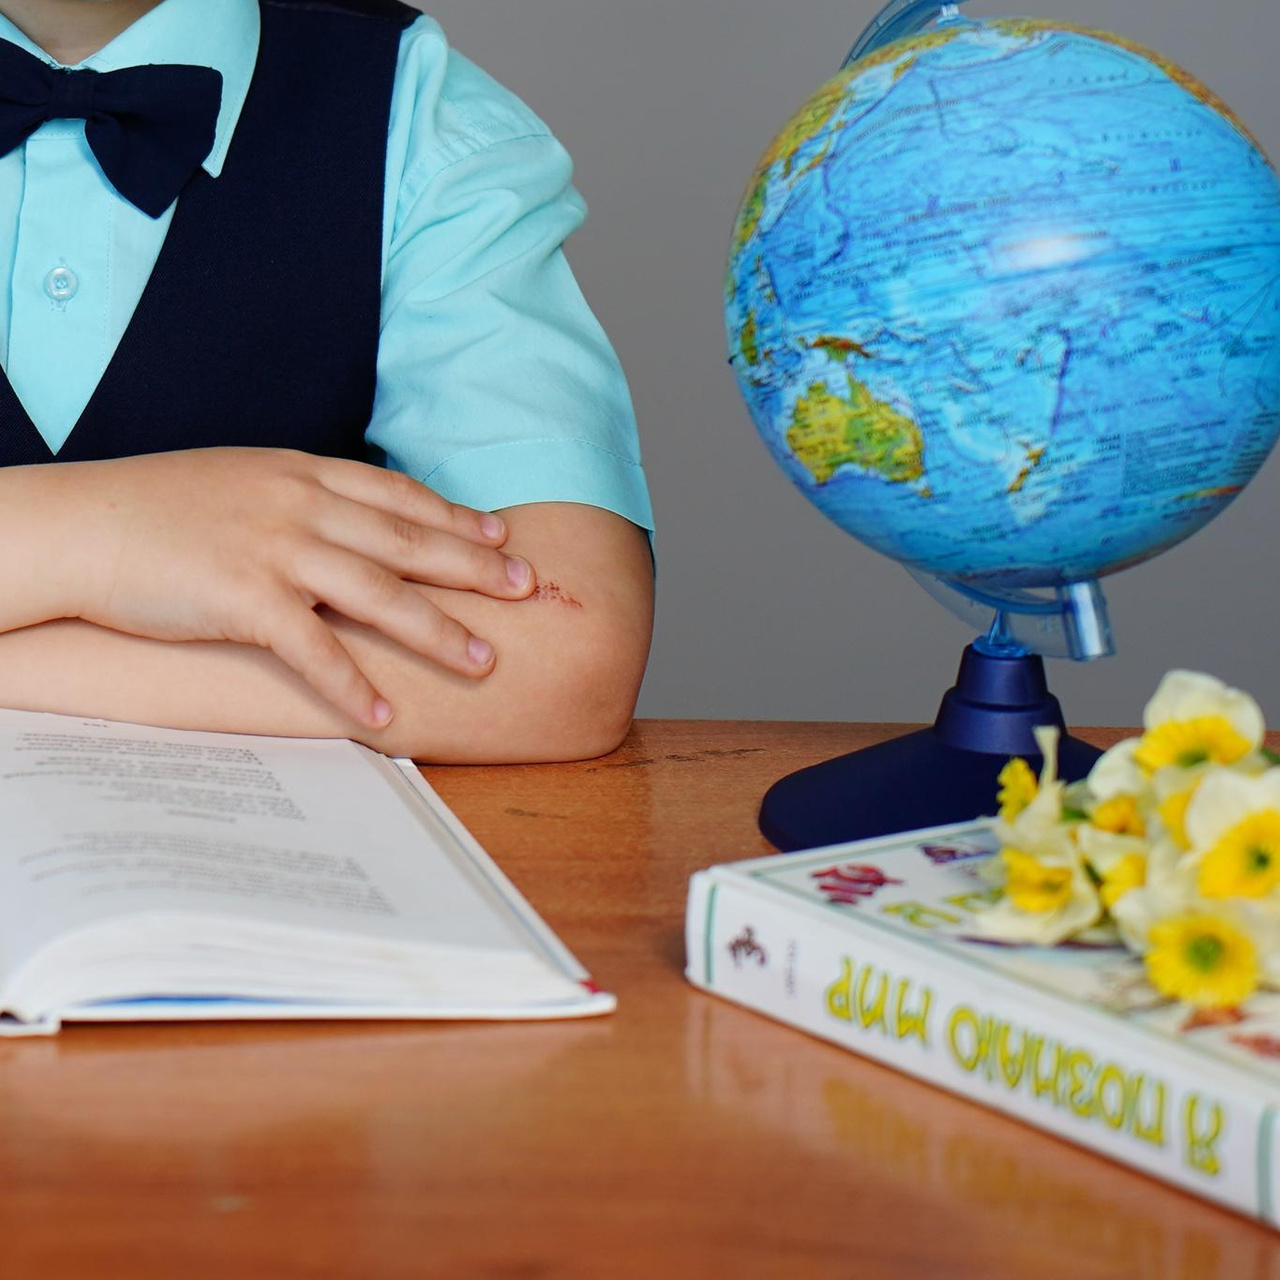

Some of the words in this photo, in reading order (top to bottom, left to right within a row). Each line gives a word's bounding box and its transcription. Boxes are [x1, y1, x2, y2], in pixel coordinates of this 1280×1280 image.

[825, 956, 933, 1047] МИР
[946, 1005, 1170, 1148] ПОЗНАЮ
[1184, 1091, 1224, 1177] Я
